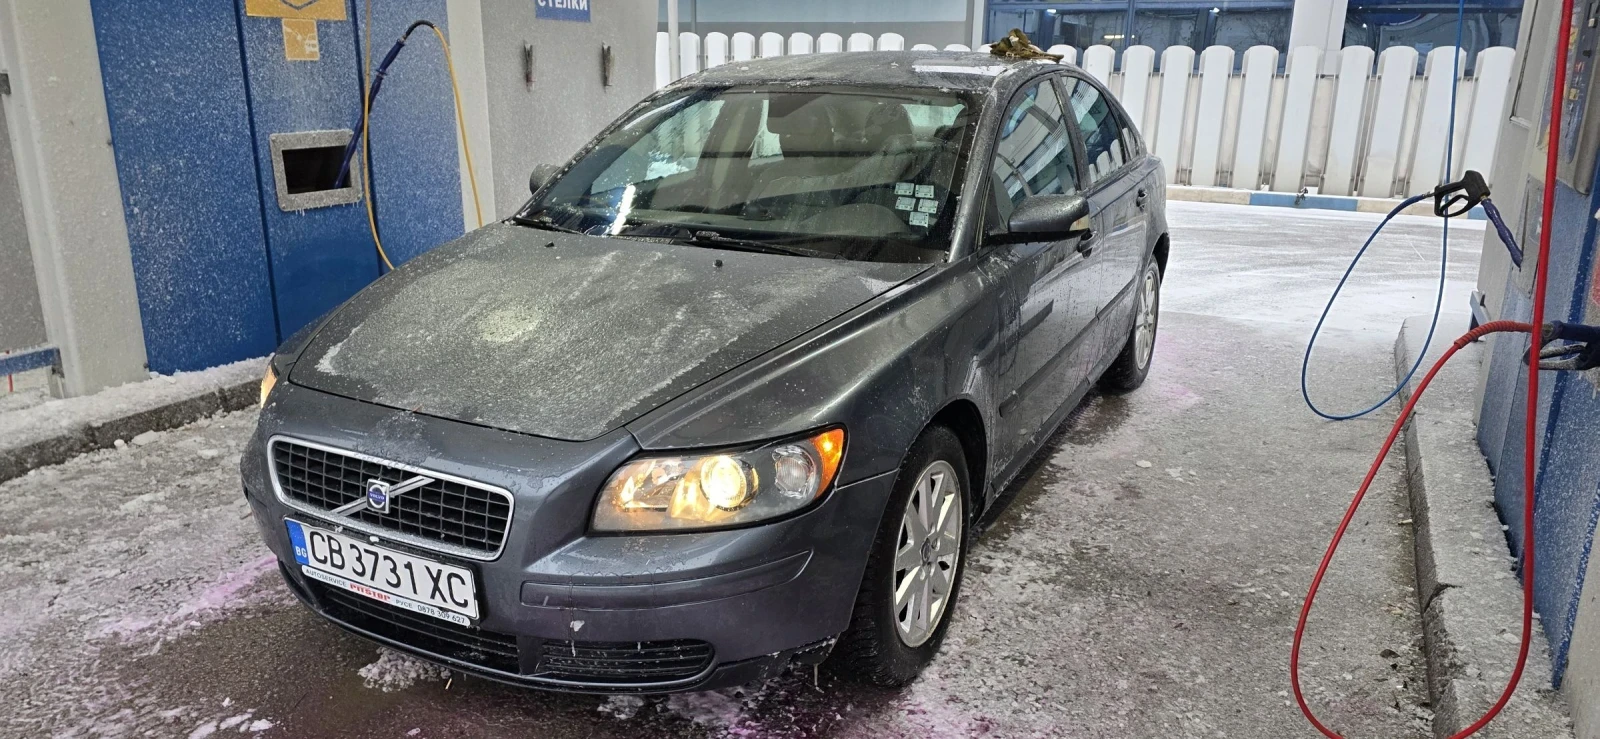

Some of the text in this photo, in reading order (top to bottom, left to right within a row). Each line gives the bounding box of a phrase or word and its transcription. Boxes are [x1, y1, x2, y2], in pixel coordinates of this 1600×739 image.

[369, 493, 385, 501] VOLVO
[295, 545, 307, 558] BG
[305, 568, 348, 587] AUTOSERVICE
[309, 531, 469, 608] CB 3731 XC
[417, 604, 435, 616] 0878
[451, 614, 465, 624] 627
